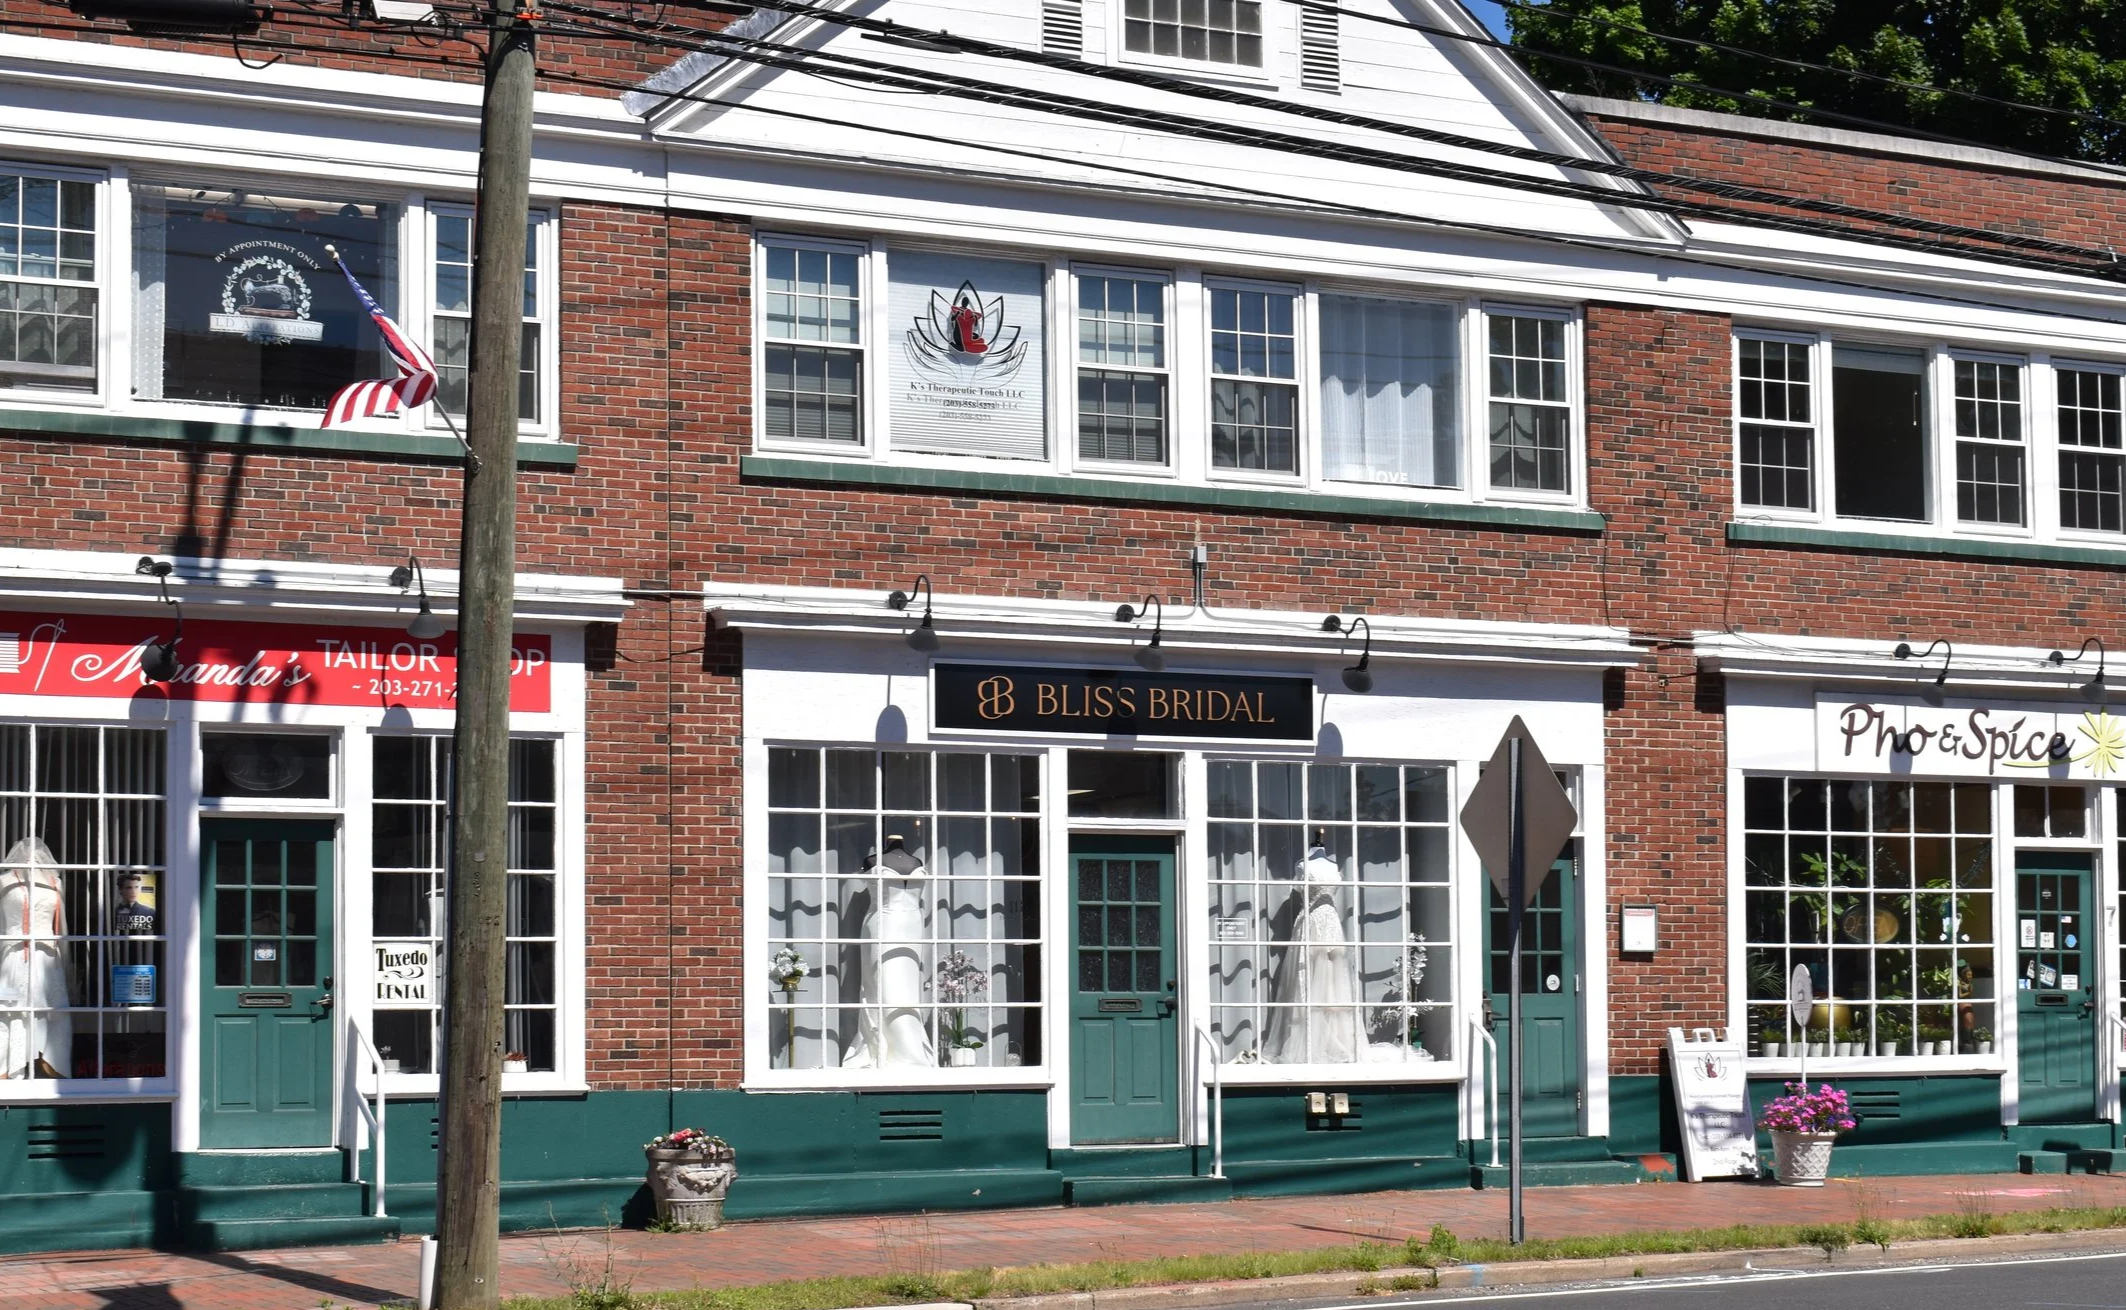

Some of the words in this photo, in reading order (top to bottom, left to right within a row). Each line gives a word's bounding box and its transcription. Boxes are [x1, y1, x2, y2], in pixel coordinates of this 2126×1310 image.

[215, 251, 227, 263] BY
[229, 240, 297, 255] APPOINTMENT
[297, 251, 321, 270] ONLY
[215, 317, 235, 328] LD
[242, 319, 320, 335] ALTERATIONS
[910, 381, 925, 390] K's
[928, 383, 977, 396] Therapeutic
[979, 388, 1004, 397] Touch
[1006, 390, 1026, 399] LLC
[316, 639, 441, 673] TAILOR
[1037, 683, 1137, 718] BLISS
[1149, 688, 1275, 723] BRIDAL
[1840, 703, 1938, 757] Pho
[117, 915, 154, 923] TUXEDO
[117, 923, 153, 931] RENTALS
[376, 948, 428, 971] Tuxedo
[377, 983, 428, 999] RENTAL
